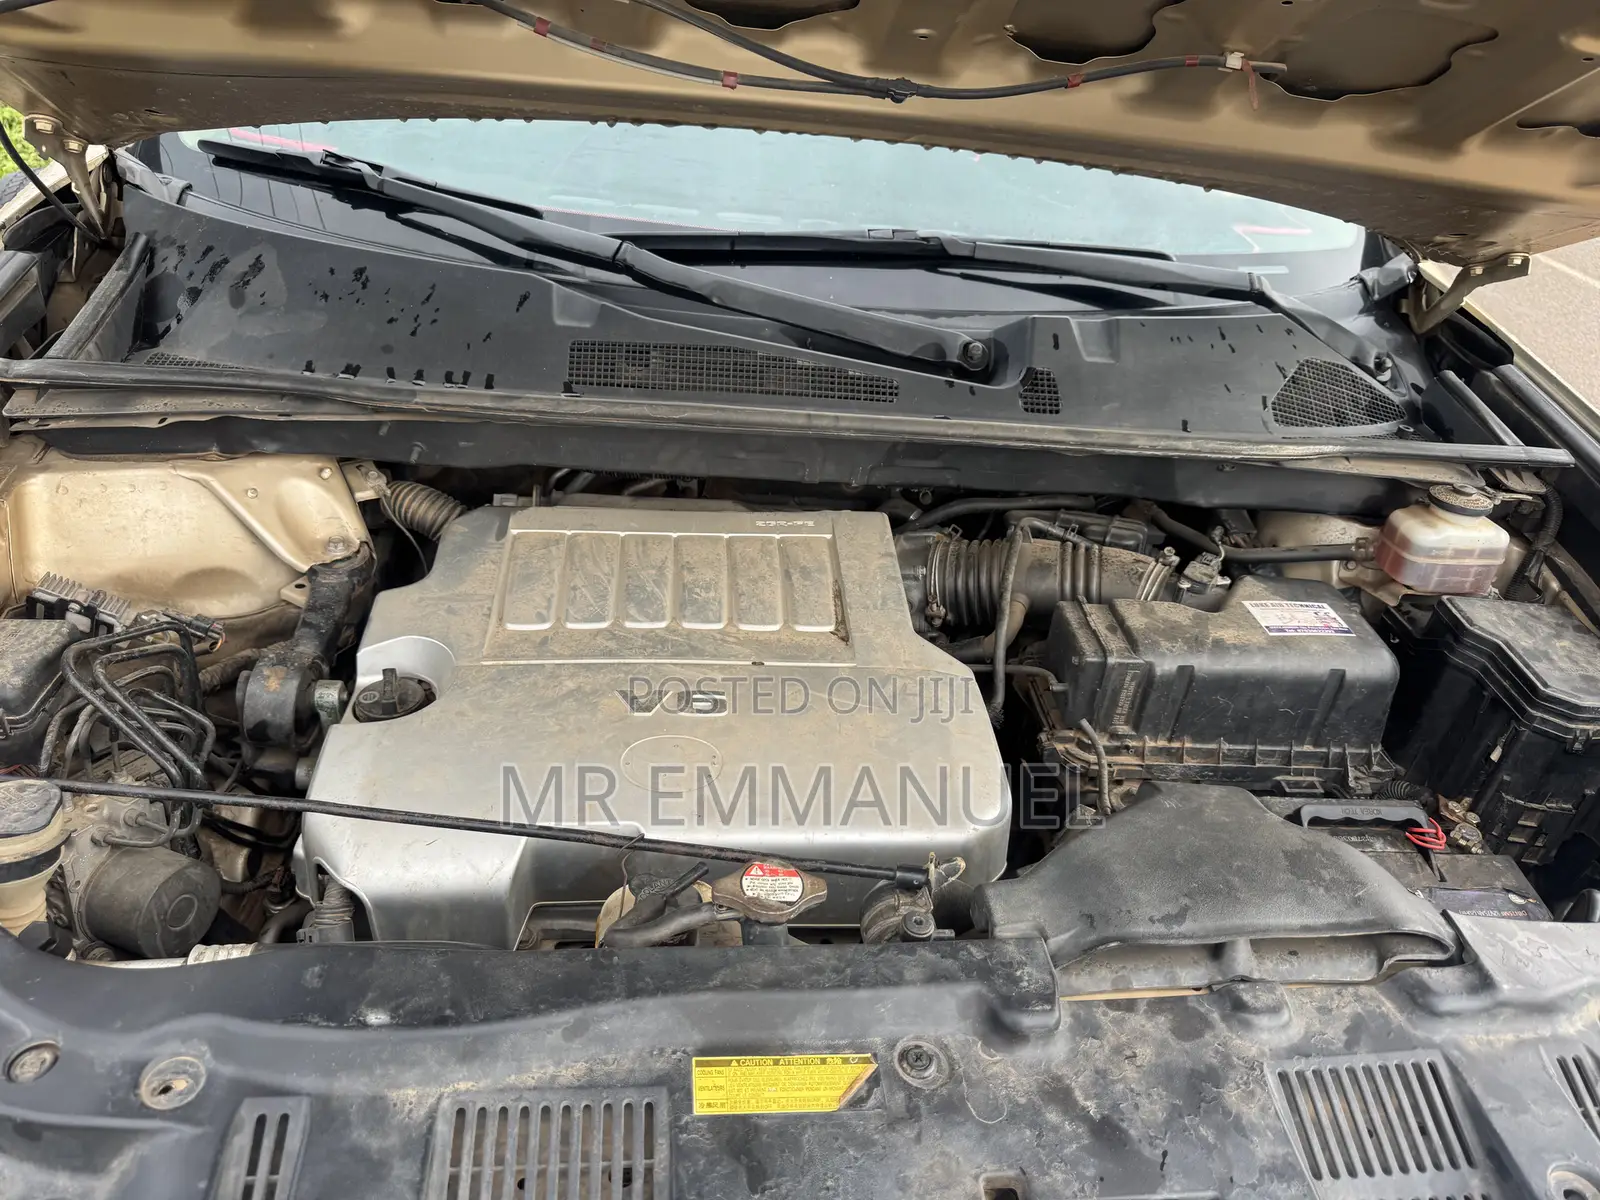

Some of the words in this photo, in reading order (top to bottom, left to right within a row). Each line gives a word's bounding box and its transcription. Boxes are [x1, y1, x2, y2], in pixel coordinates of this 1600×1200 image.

[615, 689, 728, 717] V6
[637, 879, 672, 900] OOLANT
[740, 1059, 773, 1067] CAUTION
[779, 1058, 821, 1066] ATTENTION
[714, 1068, 725, 1076] FANS
